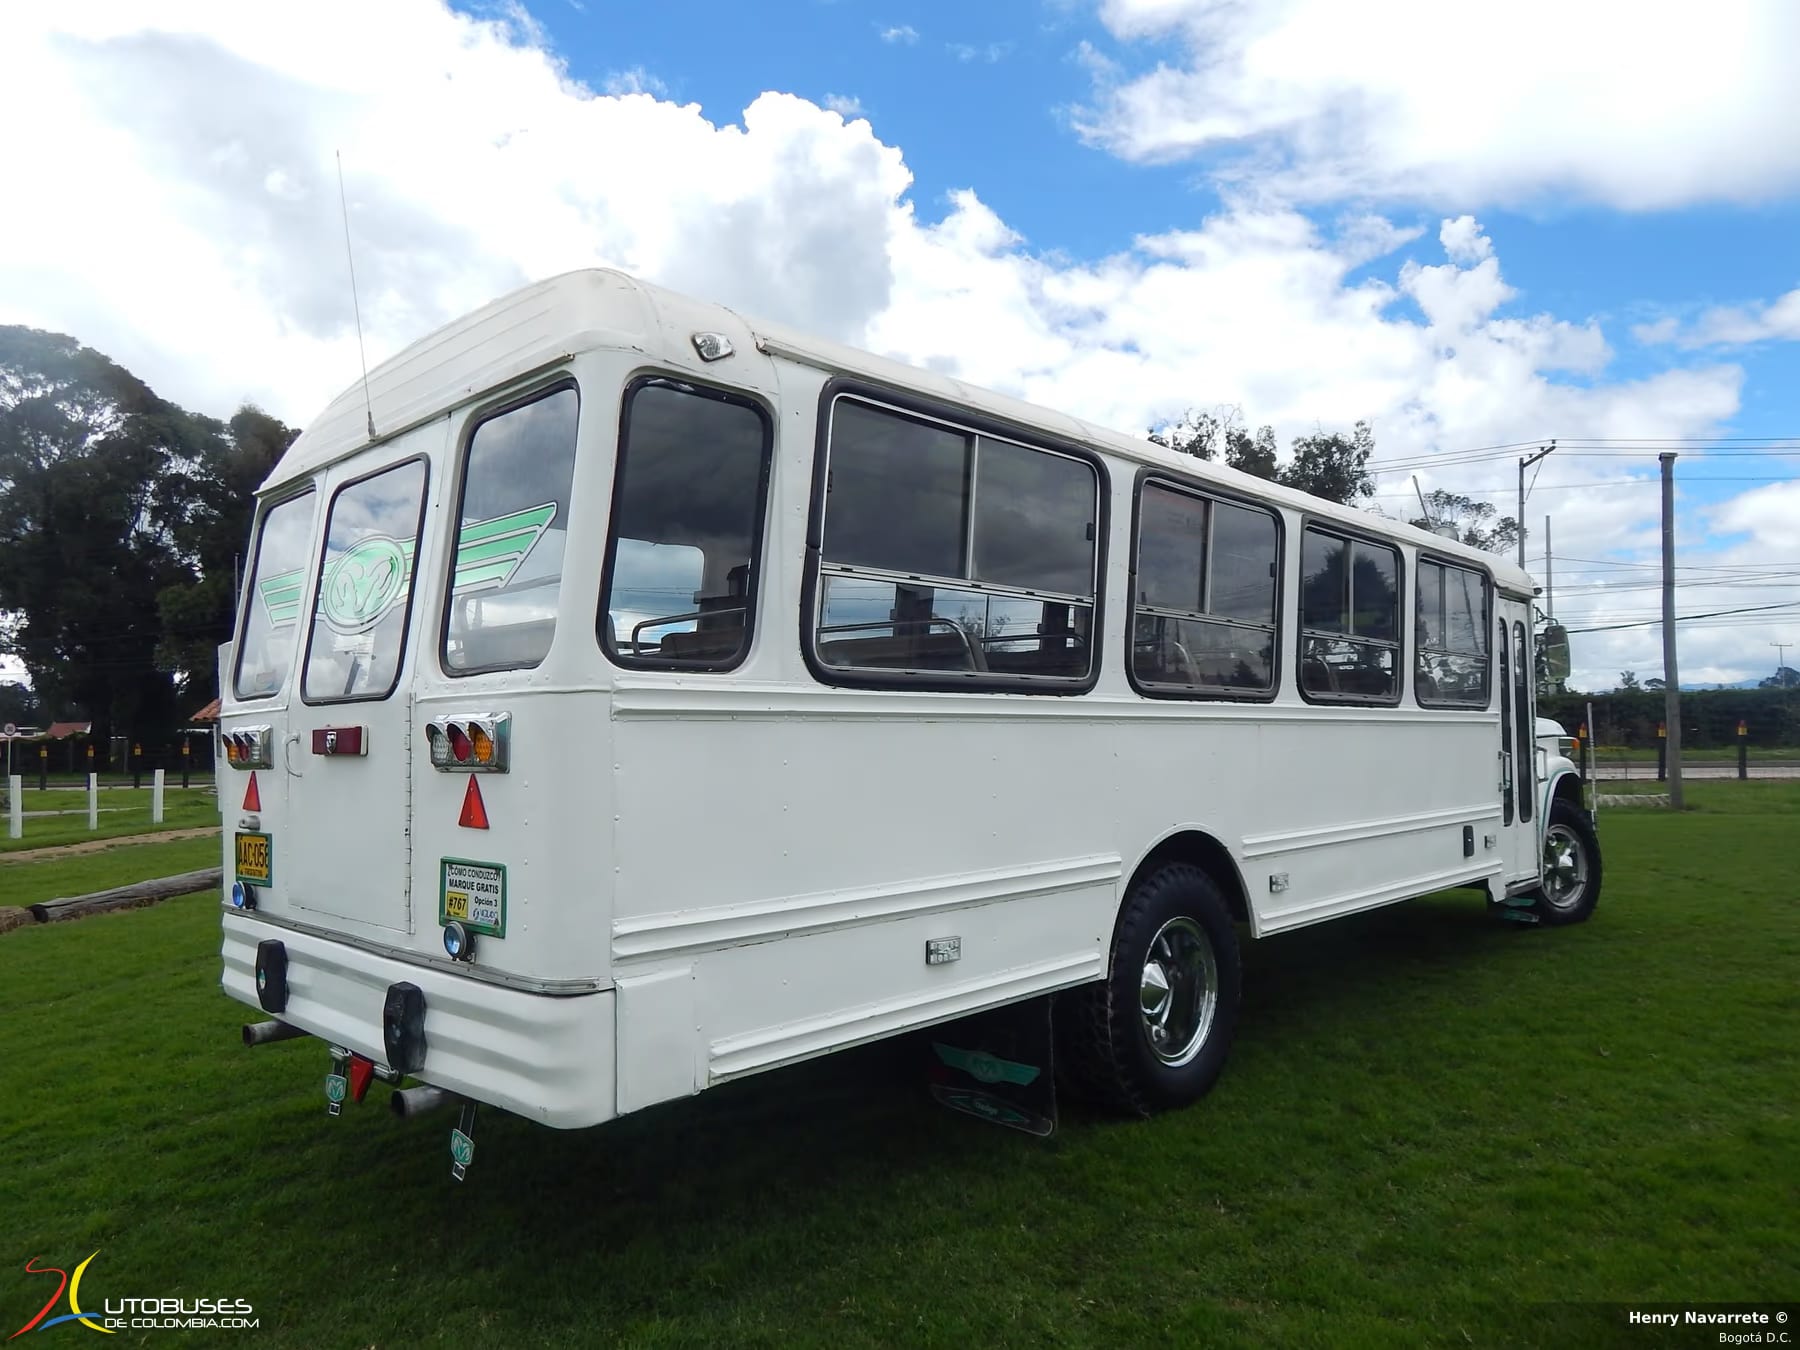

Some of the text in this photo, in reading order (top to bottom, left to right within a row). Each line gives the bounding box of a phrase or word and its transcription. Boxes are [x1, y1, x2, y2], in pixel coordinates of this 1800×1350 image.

[448, 878, 499, 895] MARQUE GRATIS
[448, 896, 467, 911] #767
[494, 899, 498, 907] 3
